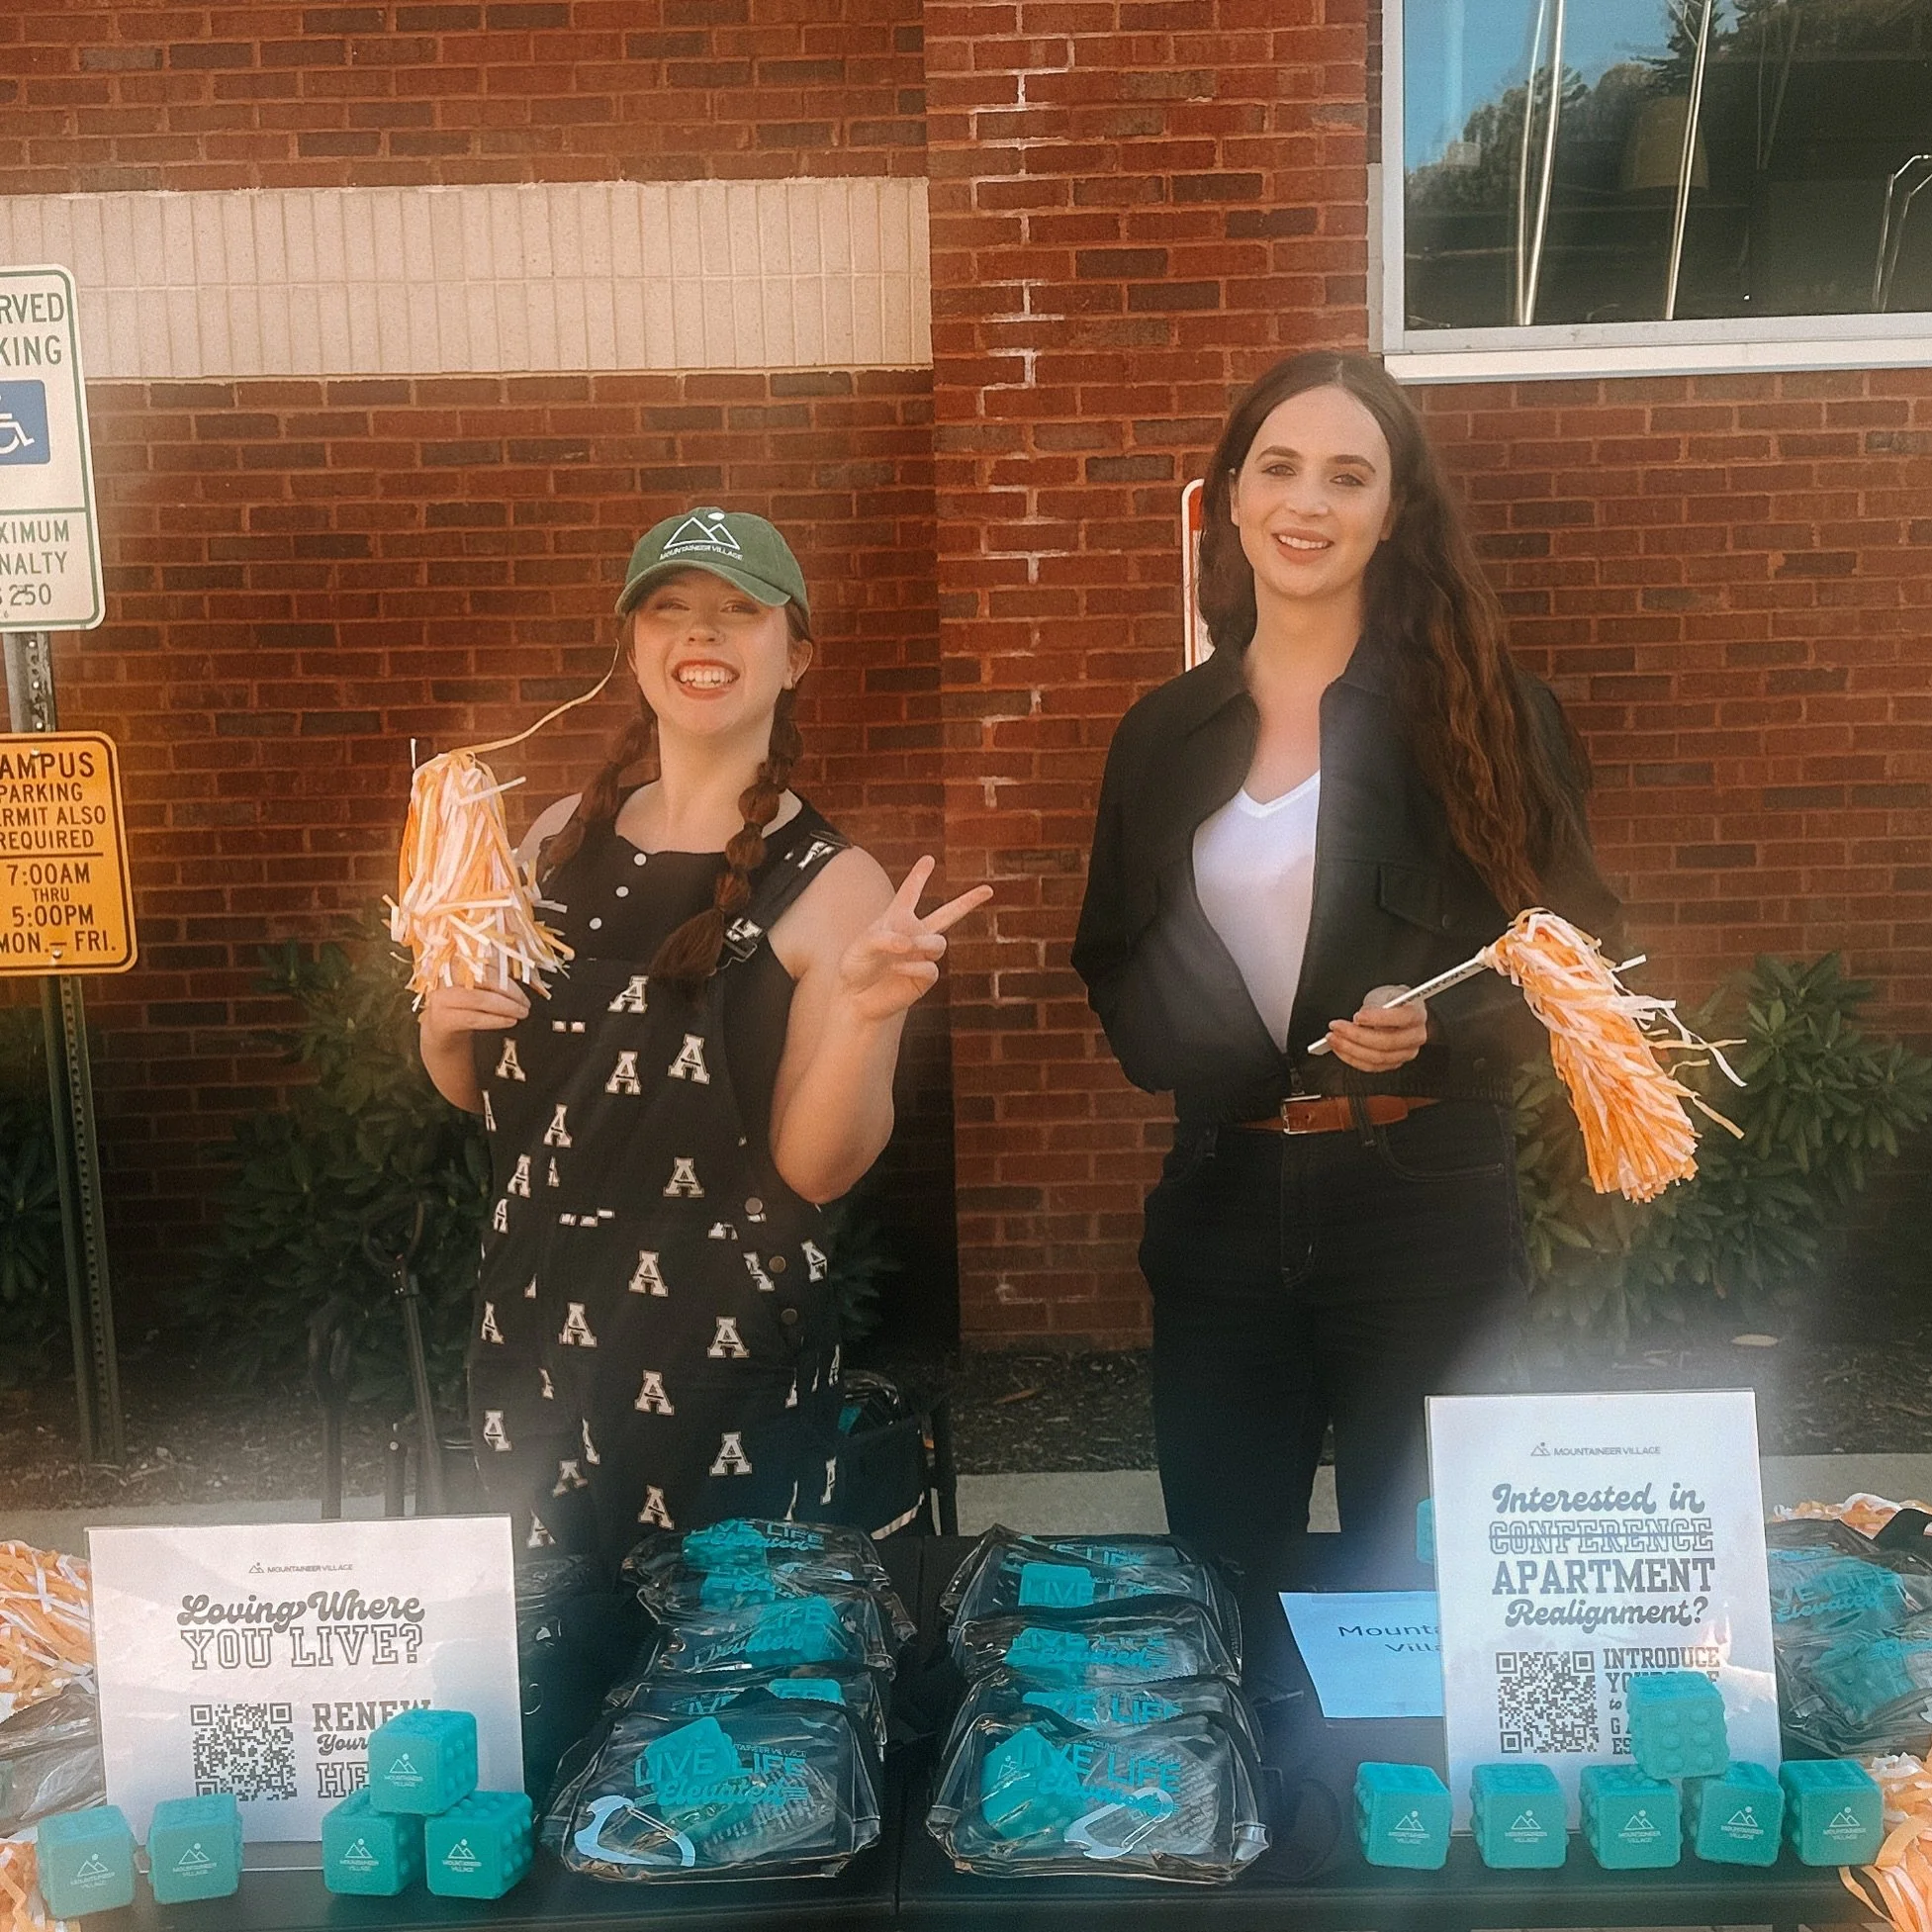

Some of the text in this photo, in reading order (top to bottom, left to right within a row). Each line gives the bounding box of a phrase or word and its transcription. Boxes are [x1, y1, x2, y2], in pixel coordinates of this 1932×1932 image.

[0, 805, 106, 827] RMIT ALSO
[6, 863, 90, 886] 7:00AM
[32, 887, 70, 902] THRU
[12, 904, 94, 928] 5:00PM
[74, 930, 116, 951] FRI.
[607, 974, 649, 1013] A
[497, 1038, 526, 1081] A
[604, 1051, 641, 1094] A
[668, 1034, 709, 1084] A
[663, 1157, 704, 1197] A
[629, 1250, 669, 1297] A
[559, 1302, 598, 1347] A
[707, 1316, 750, 1358] A
[634, 1370, 675, 1416] A
[709, 1430, 752, 1476] A
[1553, 1447, 1621, 1456] MOUNTAINEER
[638, 1485, 675, 1529] A
[1492, 1482, 1705, 1514] Interested in
[1489, 1518, 1713, 1554] CONFERENCE
[267, 1565, 322, 1574] MOUNTAINEER
[1492, 1557, 1715, 1595] APARTMENT
[177, 1589, 425, 1633] Loving Where
[1505, 1596, 1708, 1633] Realignment?
[180, 1623, 422, 1670] YOU LIVE?
[1603, 1647, 1720, 1669] INTRODUCE
[1610, 1698, 1621, 1710] to
[317, 1733, 368, 1756] Your
[634, 1748, 807, 1788] LIVE LIFE
[1108, 1752, 1181, 1793] LIFE
